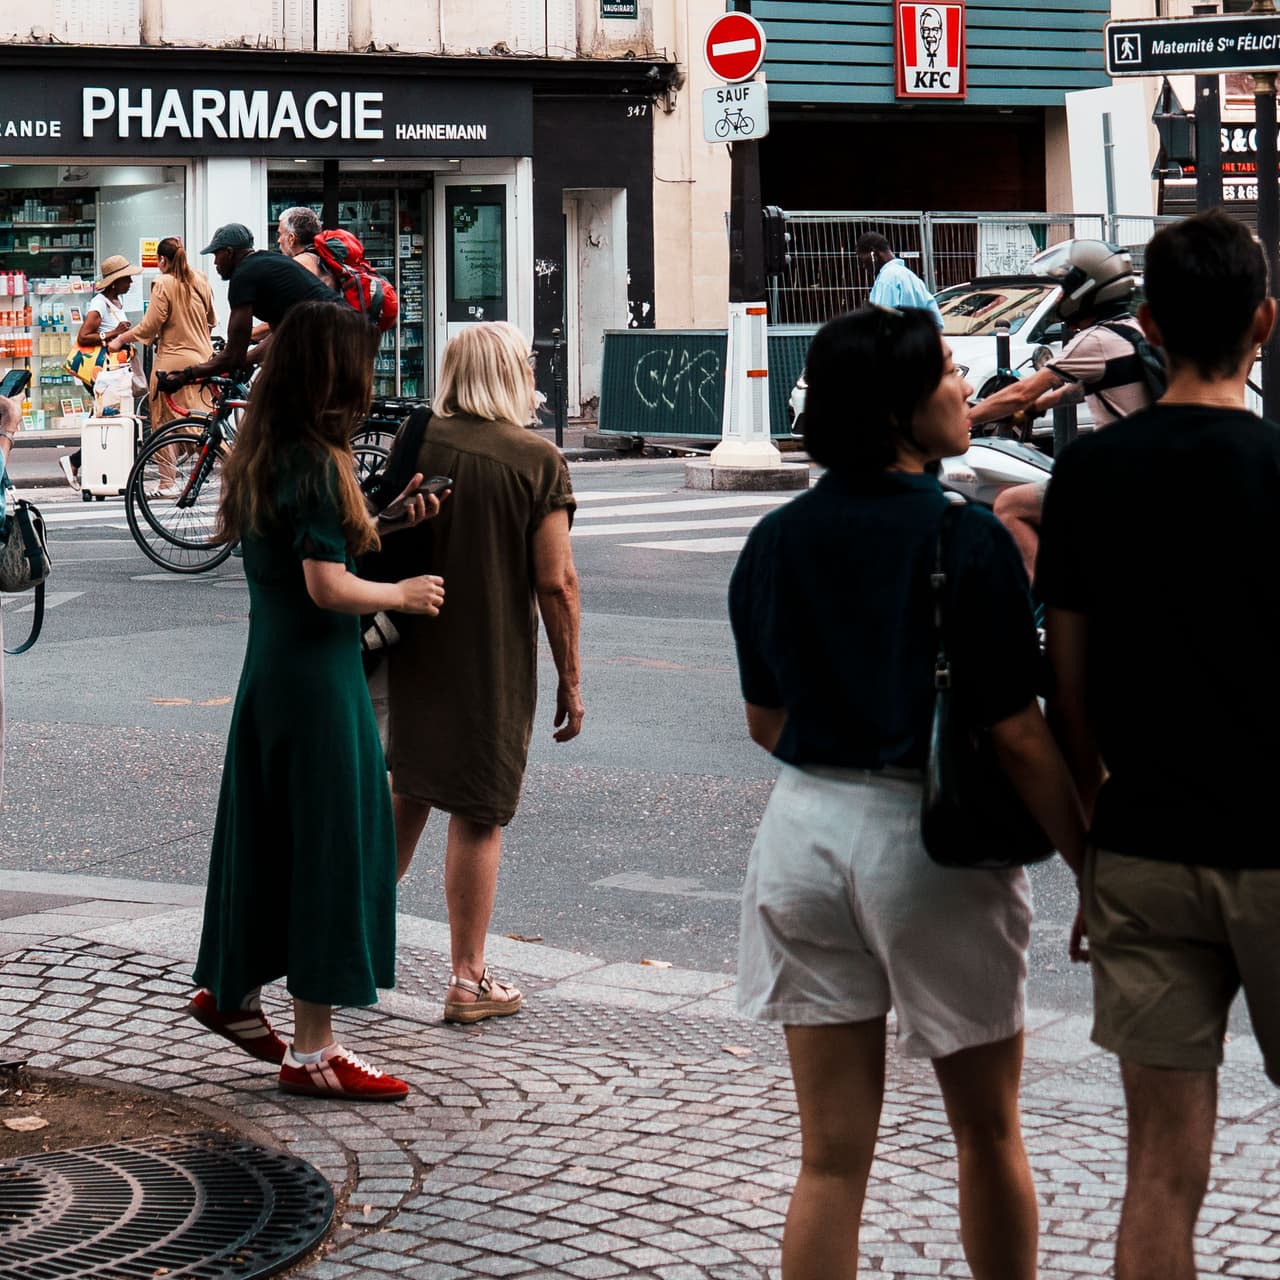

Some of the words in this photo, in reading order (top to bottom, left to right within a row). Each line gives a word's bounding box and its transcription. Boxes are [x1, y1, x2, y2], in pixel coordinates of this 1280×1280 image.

[603, 4, 634, 13] VAUGIRARD
[1151, 37, 1213, 55] Maternité
[1217, 37, 1235, 51] Ste
[914, 71, 951, 89] KFC
[717, 88, 750, 103] SAUF
[82, 87, 384, 140] PHARMACIE
[395, 124, 487, 140] HAHNEMANN
[627, 104, 647, 118] 347
[1237, 161, 1257, 172] TABL
[1222, 185, 1235, 200] ES
[1246, 185, 1258, 200] GS
